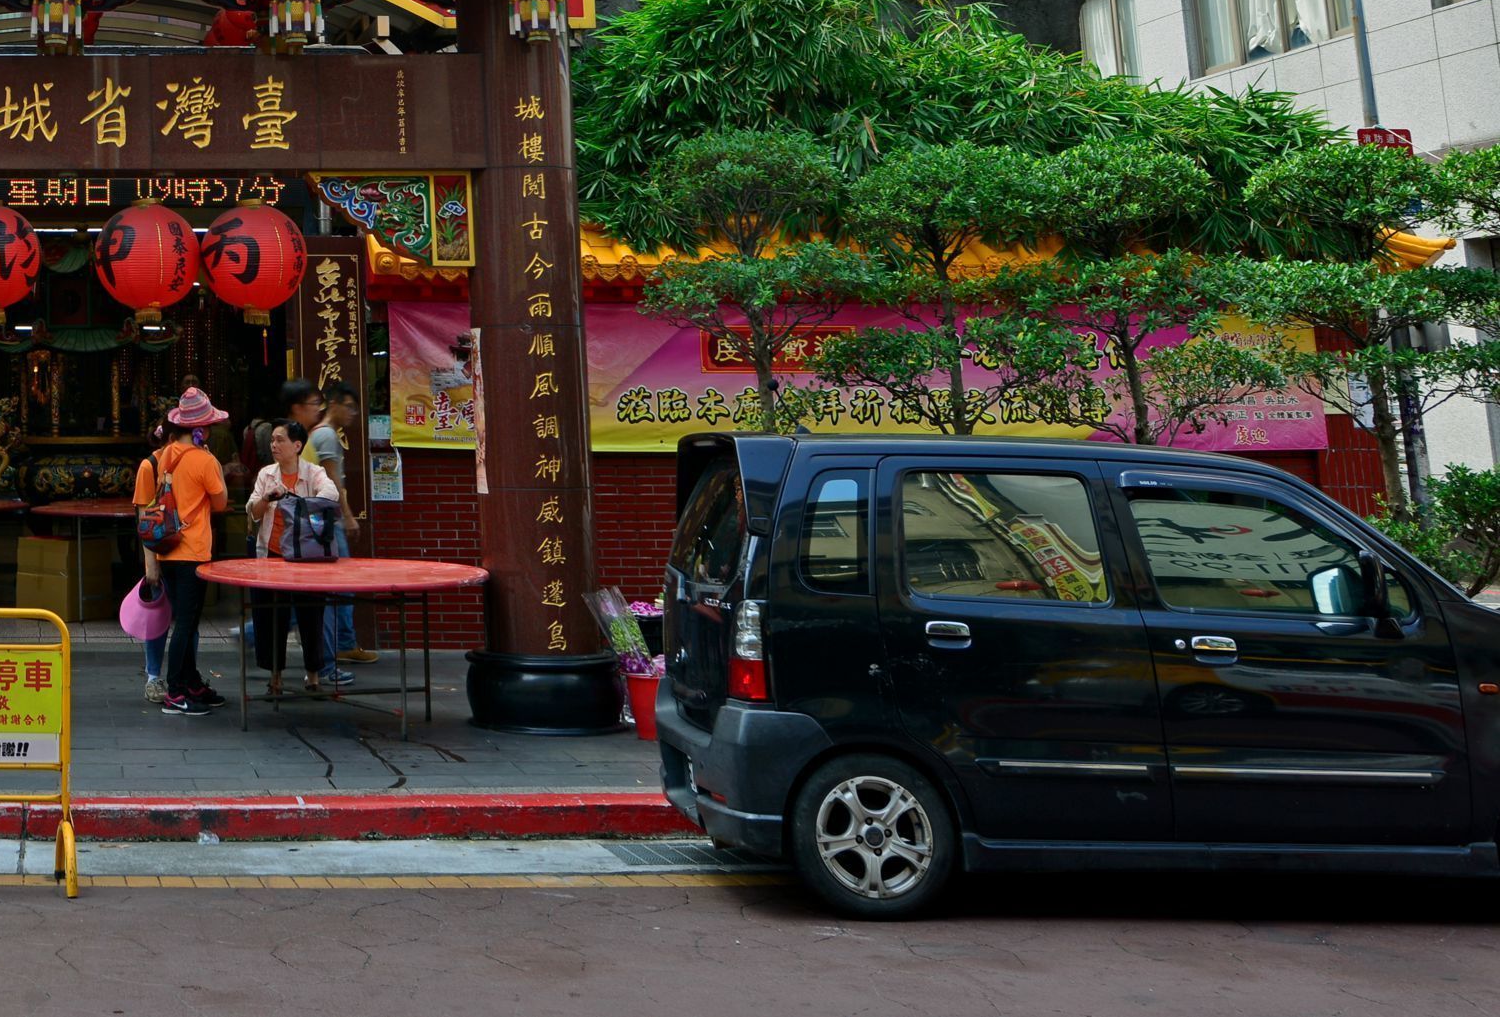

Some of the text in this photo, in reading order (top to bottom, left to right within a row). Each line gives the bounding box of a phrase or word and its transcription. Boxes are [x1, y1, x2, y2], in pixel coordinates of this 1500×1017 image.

[7, 177, 112, 206] 星期日
[167, 221, 189, 292] 國泰民安
[202, 216, 261, 285] 丙
